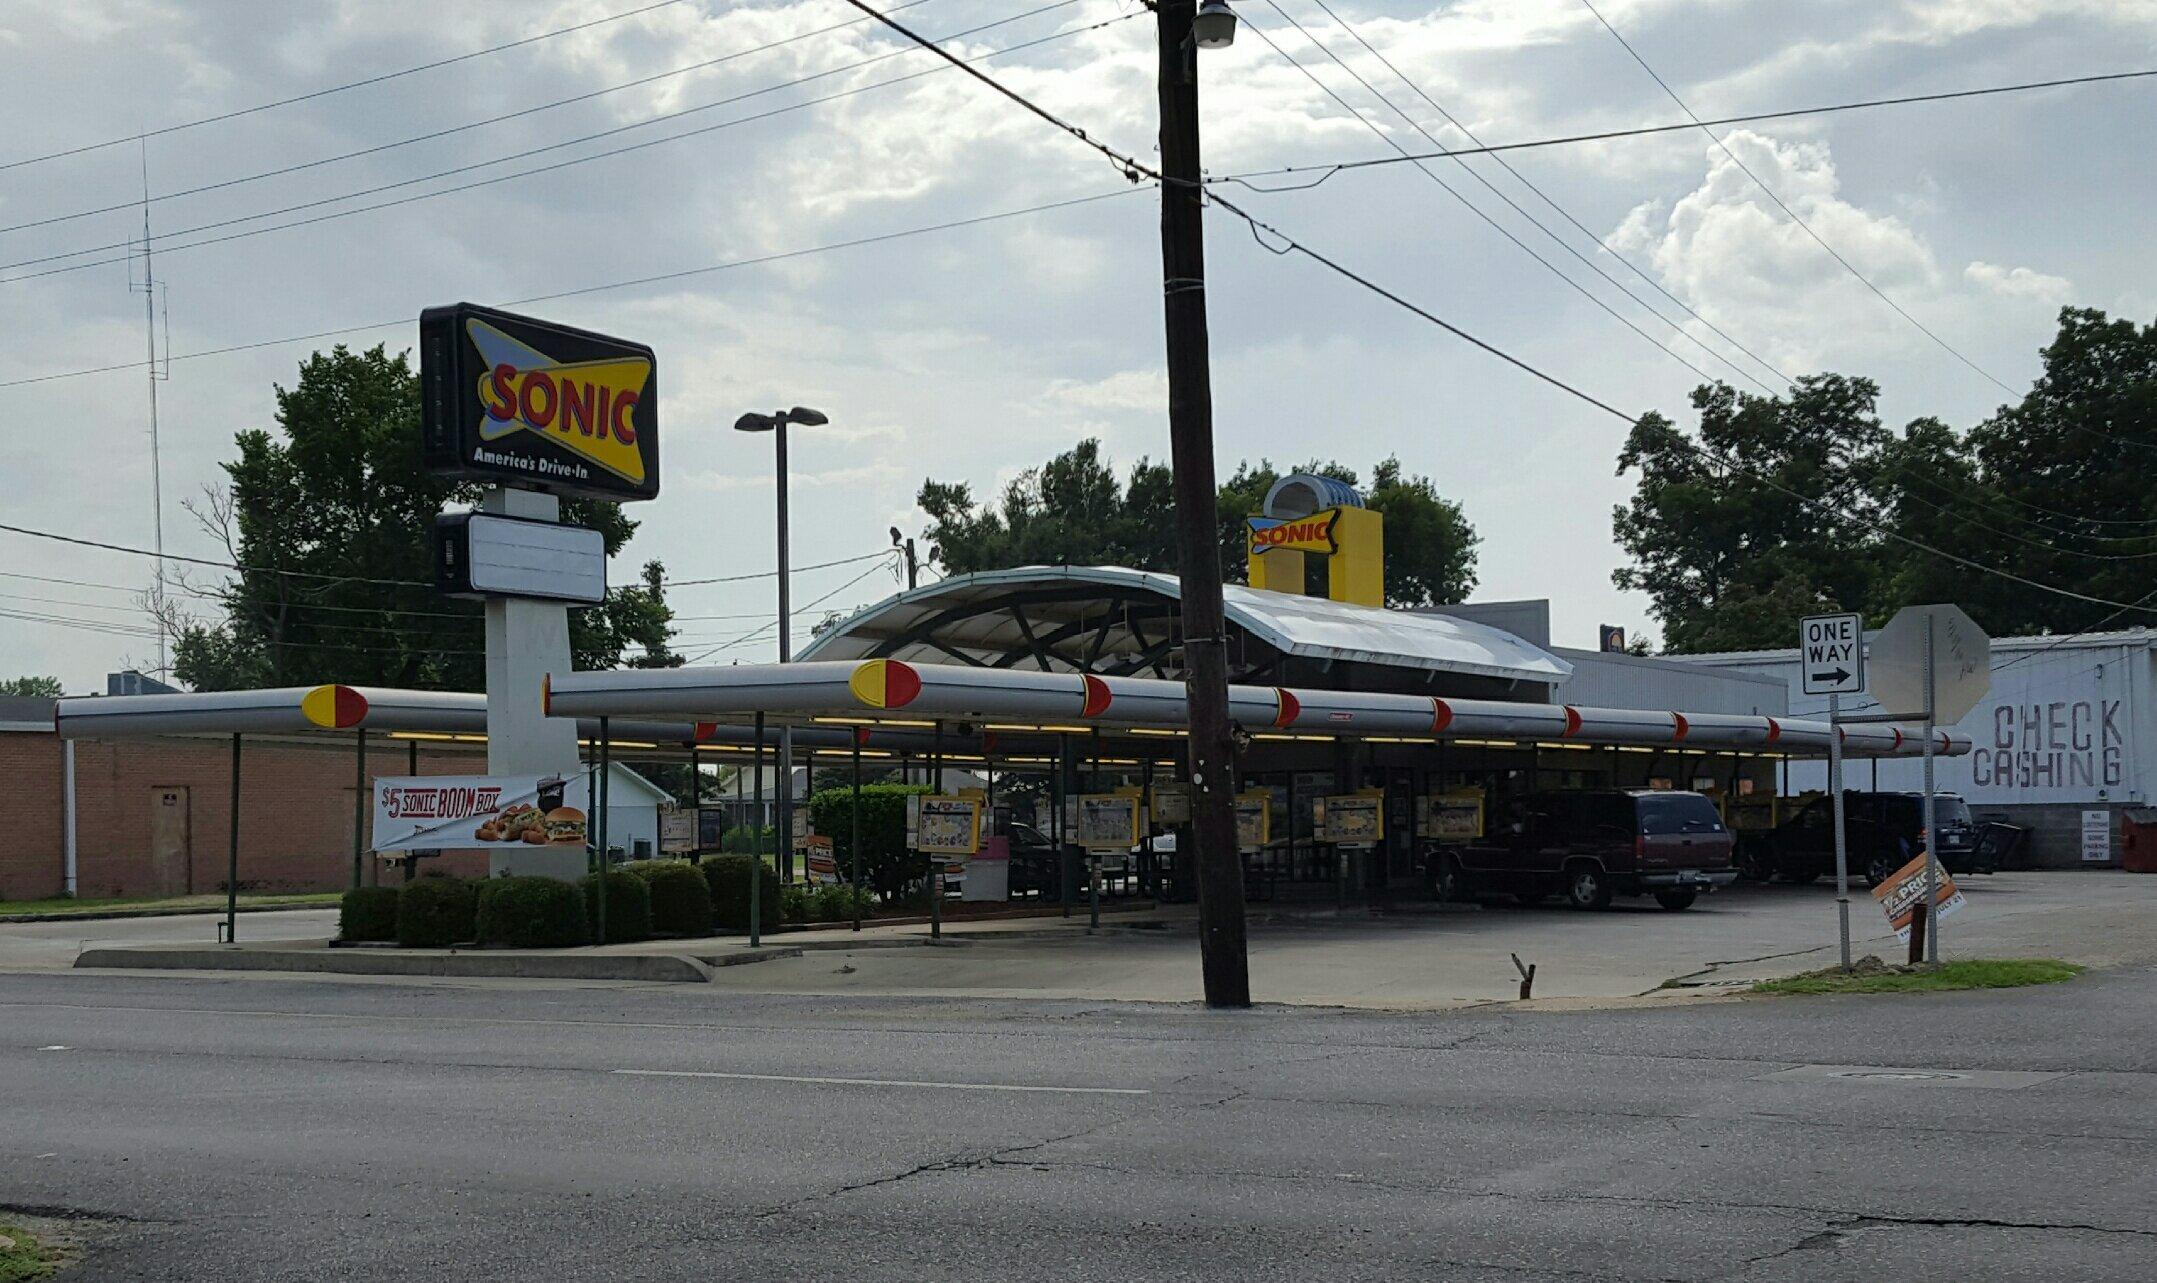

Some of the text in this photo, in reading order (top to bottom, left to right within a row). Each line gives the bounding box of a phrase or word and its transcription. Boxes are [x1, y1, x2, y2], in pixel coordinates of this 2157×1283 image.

[485, 363, 640, 446] SONIC
[473, 447, 589, 480] America's Drive-In
[1256, 521, 1329, 545] SONIC
[1809, 621, 1851, 642] ONE
[1809, 643, 1853, 663] WAY
[1994, 700, 2122, 751] CHECK
[1973, 746, 2122, 788] CASHING
[381, 787, 500, 818] $5 SONIC BOOM BOX
